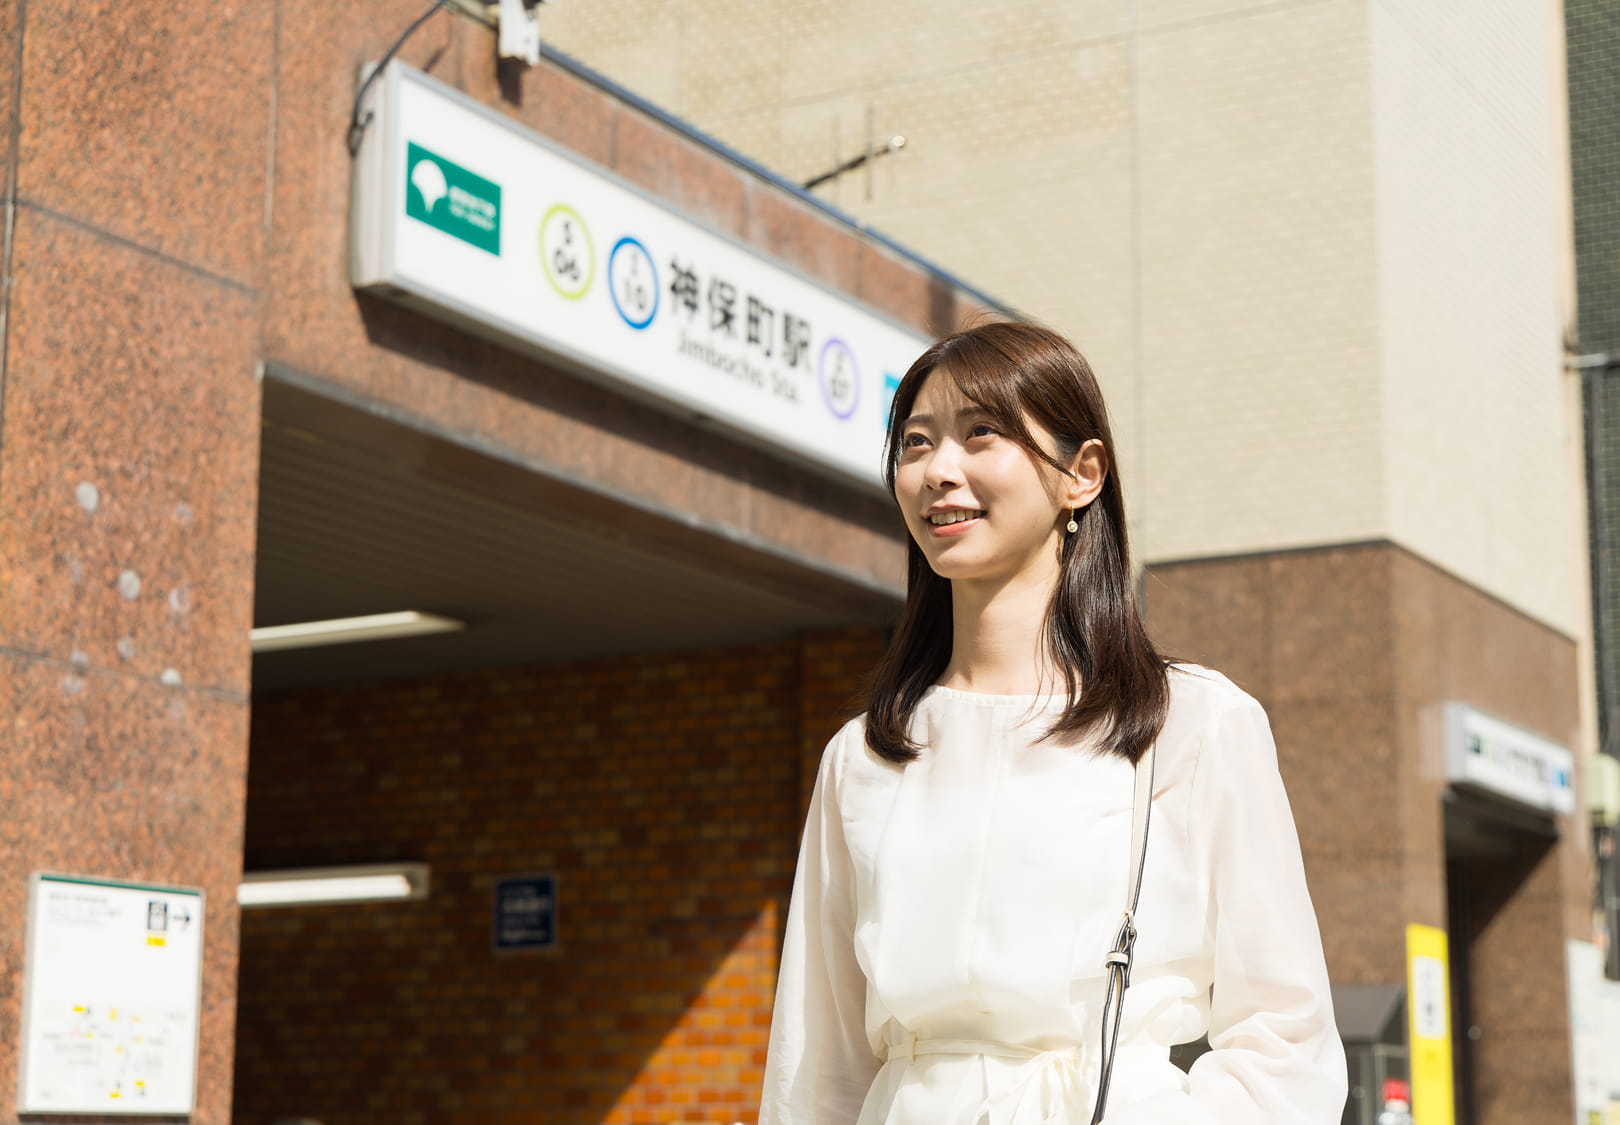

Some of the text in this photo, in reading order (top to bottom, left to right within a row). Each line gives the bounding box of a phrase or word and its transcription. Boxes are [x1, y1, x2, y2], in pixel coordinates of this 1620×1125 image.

[552, 248, 581, 282] 06
[624, 279, 648, 311] 10
[669, 256, 812, 374] 神保町駅
[677, 330, 764, 389] Jimbocho
